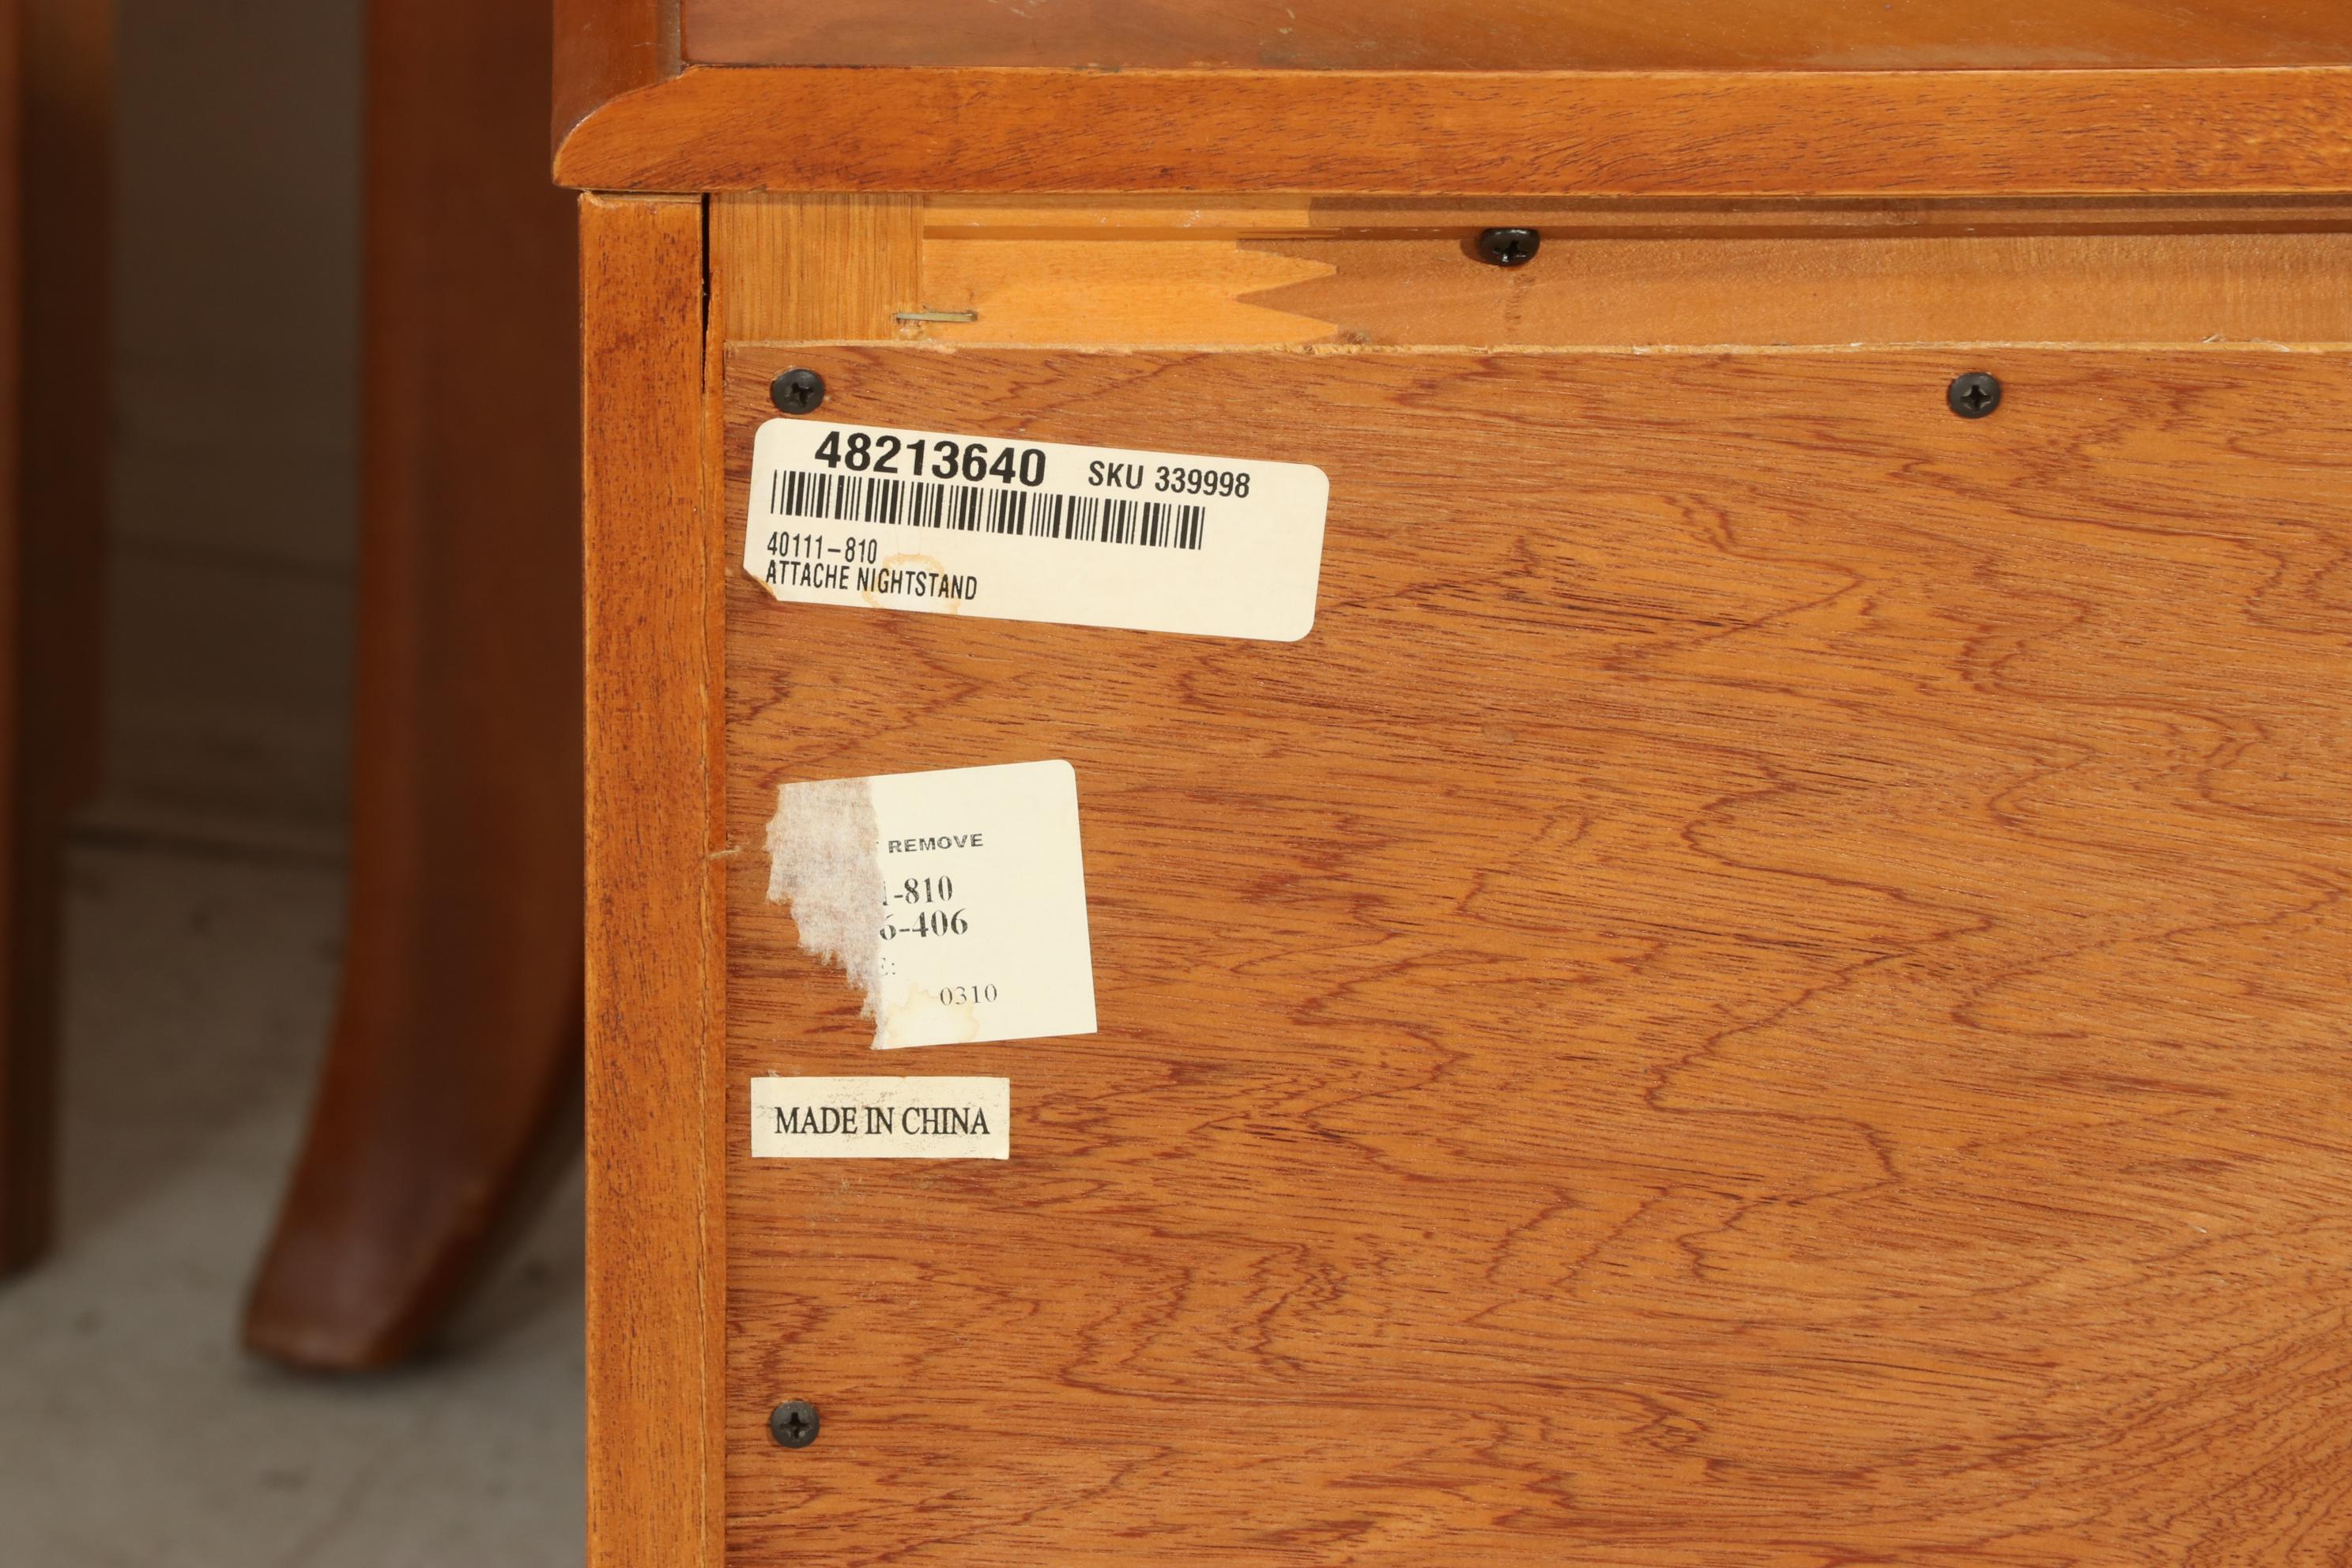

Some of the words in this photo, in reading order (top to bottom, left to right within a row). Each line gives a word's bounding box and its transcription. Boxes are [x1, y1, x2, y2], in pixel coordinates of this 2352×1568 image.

[815, 431, 1046, 487] 48213640
[1088, 461, 1143, 490] SKU
[1155, 466, 1250, 499] 339998
[767, 532, 878, 564] 40111-810
[766, 561, 849, 590] ATTACHE
[857, 568, 978, 601] NIGHTSTAND
[888, 833, 984, 854] REMOVE
[939, 983, 998, 1006] 0310
[775, 1106, 858, 1134] MADE
[865, 1107, 895, 1134] IN
[902, 1107, 991, 1135] CHINA
